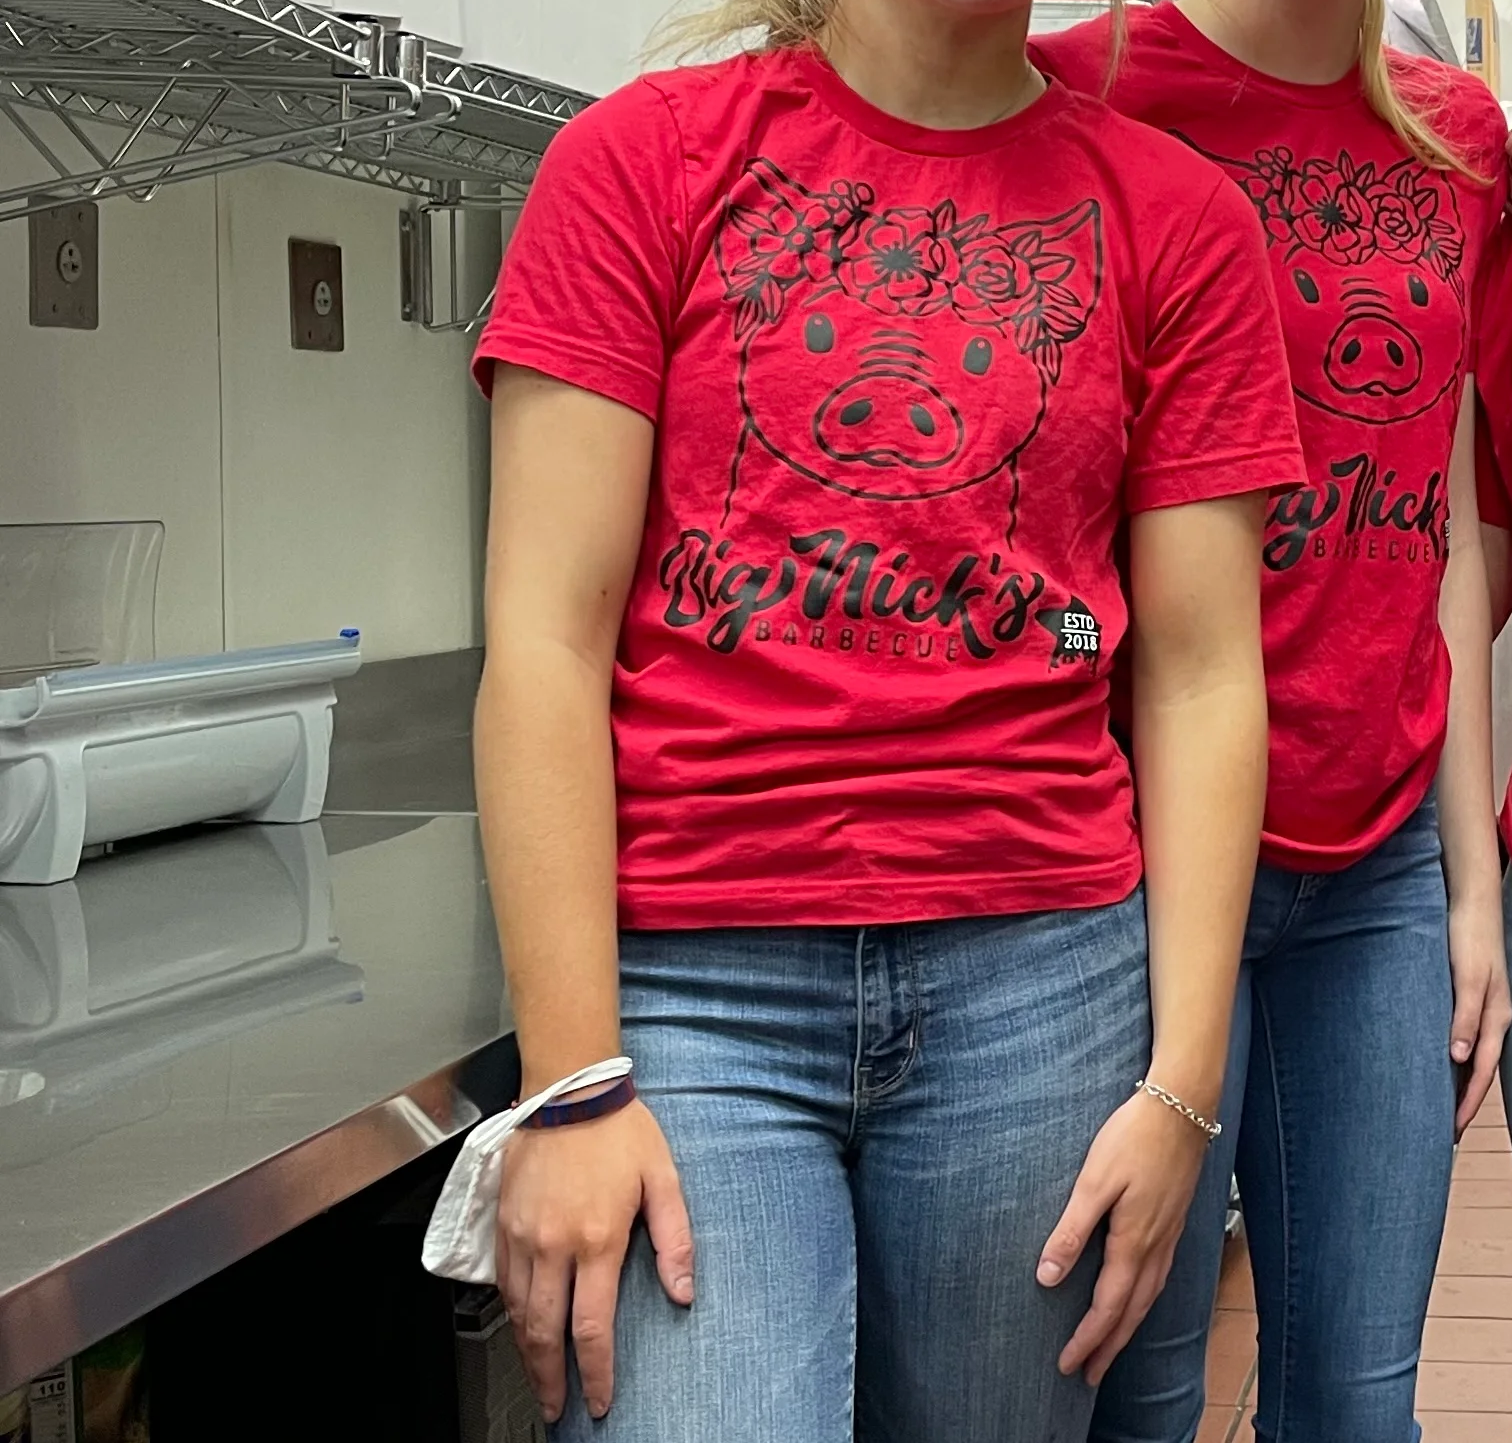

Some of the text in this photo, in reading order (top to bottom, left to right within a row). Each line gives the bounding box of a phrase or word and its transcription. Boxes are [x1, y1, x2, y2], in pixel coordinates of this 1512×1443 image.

[659, 528, 1045, 659] Big Nick's
[1064, 612, 1095, 630] ESTD
[755, 620, 959, 662] BARBECUE
[1064, 633, 1098, 651] 2018
[40, 1381, 66, 1395] 110
